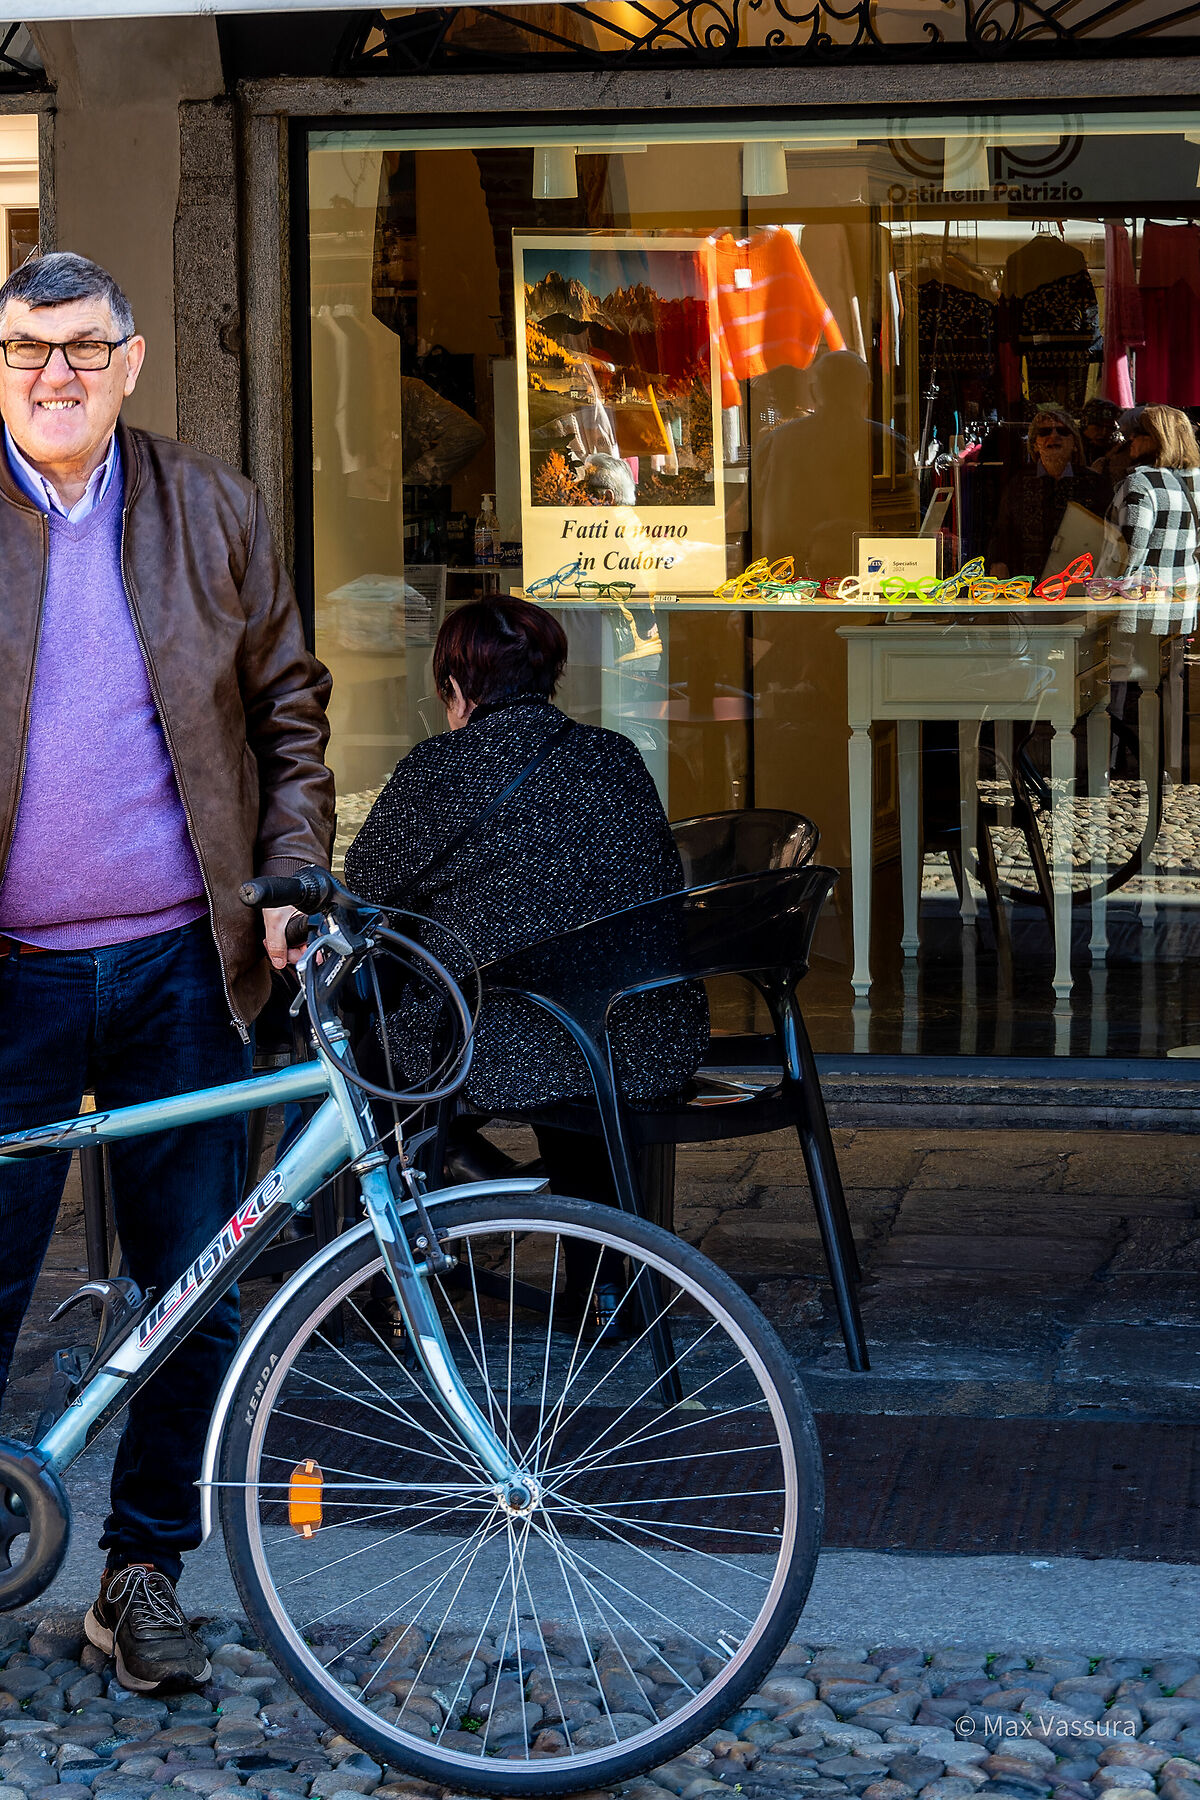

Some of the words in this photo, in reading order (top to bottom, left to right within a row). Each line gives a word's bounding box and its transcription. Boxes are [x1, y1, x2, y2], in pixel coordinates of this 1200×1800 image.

[994, 181, 1083, 202] Patrizio
[560, 519, 609, 539] Fatti
[614, 525, 625, 539] a
[633, 524, 688, 539] mano
[577, 551, 596, 571] in
[603, 551, 675, 571] Cadore
[244, 1353, 279, 1426] KENDA
